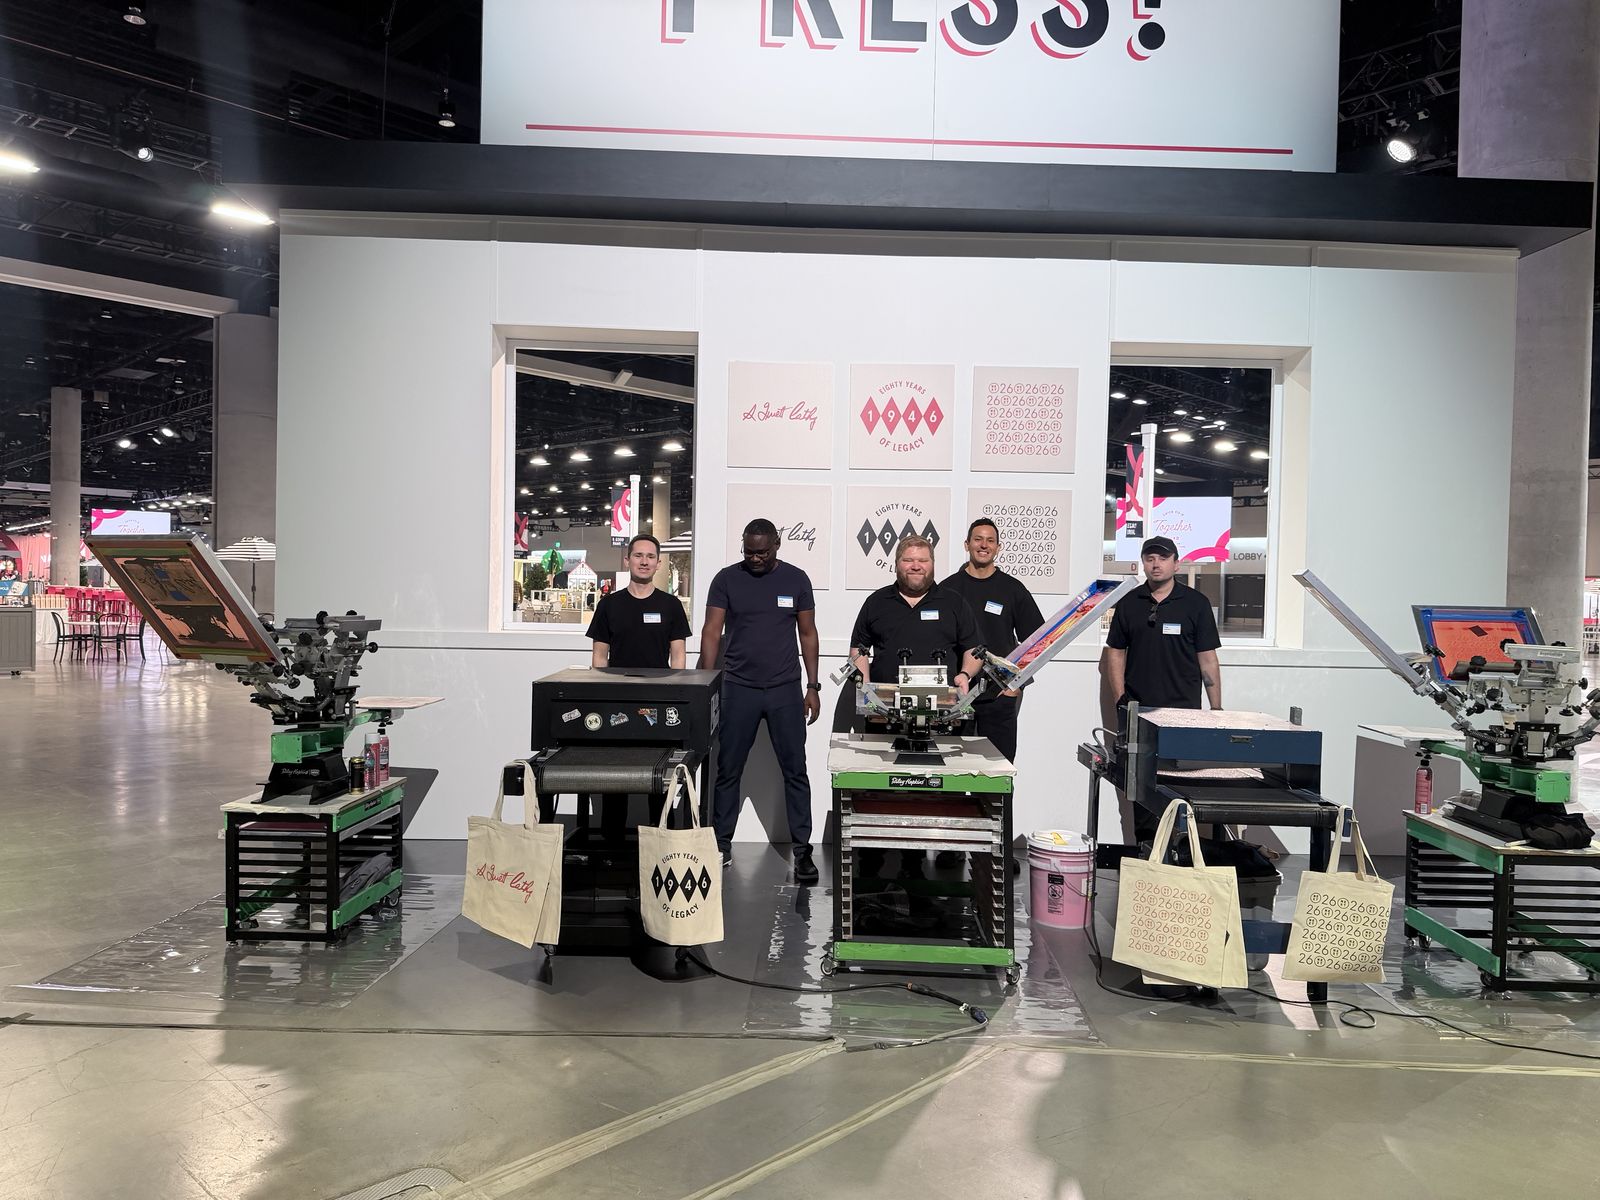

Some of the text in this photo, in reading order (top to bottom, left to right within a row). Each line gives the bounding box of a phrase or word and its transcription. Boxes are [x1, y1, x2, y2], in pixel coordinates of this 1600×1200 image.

[879, 381, 926, 394] EIGHTY YEARS
[1000, 383, 1064, 394] 26 26 26
[987, 395, 1050, 406] 26 26 26
[999, 408, 1063, 419] 26 26 26
[986, 420, 1049, 431] 26 26 26
[998, 432, 1062, 443] 26 26 26
[880, 437, 924, 452] OF LEGACY
[985, 444, 1049, 455] 26 26 26
[876, 503, 922, 516] EIGHTY YEARS
[994, 505, 1058, 516] 26 26 26
[1007, 518, 1044, 528] 26 26
[1153, 520, 1192, 535] Together
[1019, 530, 1031, 540] 26
[1044, 531, 1057, 540] 26
[1006, 542, 1044, 552] 26 26
[876, 559, 887, 569] OF
[1018, 554, 1030, 564] 26
[1043, 555, 1056, 564] 26
[1030, 566, 1043, 576] 26
[662, 853, 698, 863] EIGHTY YEARS
[1147, 883, 1214, 905] 26 26 26
[1133, 891, 1199, 914] 26 26 26
[1322, 895, 1336, 906] 26
[1350, 901, 1364, 913] 26
[663, 904, 698, 918] OF LEGACY
[1145, 906, 1211, 929] 26 26 26
[1307, 905, 1377, 928] 26 26 26
[1131, 915, 1196, 938] 26 26 26
[1318, 919, 1386, 942] 26 26 2
[1142, 930, 1208, 953] 26 26 26
[1303, 929, 1373, 952] 26 26 26
[1129, 938, 1193, 962] 26 26 26
[1314, 944, 1328, 955] 26
[1342, 950, 1357, 961] 26
[1299, 953, 1366, 972] 26 26 26
